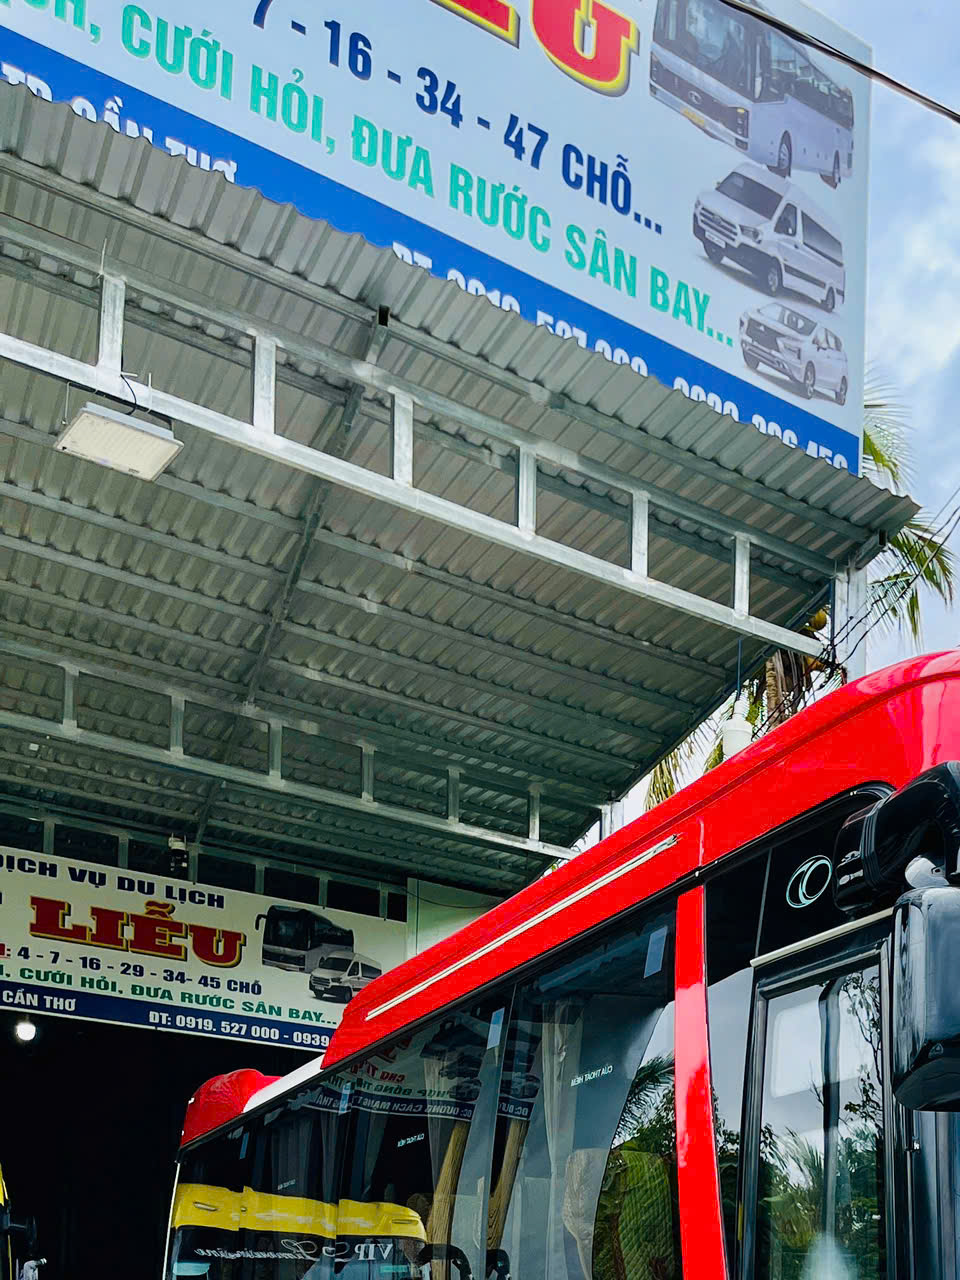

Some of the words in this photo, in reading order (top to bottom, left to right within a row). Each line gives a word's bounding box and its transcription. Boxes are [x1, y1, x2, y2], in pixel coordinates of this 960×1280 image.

[323, 20, 372, 80] 16
[416, 66, 463, 129] 34
[504, 113, 549, 171] 47
[561, 143, 663, 235] CHỖ...
[122, 5, 234, 101] CƯỚI
[249, 64, 335, 156] HỎI,
[351, 114, 436, 198] ĐƯA
[449, 162, 552, 253] RƯỚC
[564, 222, 637, 299] SÂN
[650, 266, 733, 348] BAY...
[0, 855, 57, 878] ỊCH
[68, 866, 107, 889] VỤ
[117, 876, 155, 896] DU
[165, 885, 225, 909] LỊCH
[29, 895, 247, 969] LIỄU
[17, 946, 30, 960] 4
[50, 951, 60, 964] 7
[79, 956, 101, 970] 16
[120, 962, 144, 977] 29
[197, 975, 221, 989] 45
[19, 967, 73, 986] CƯỚI
[131, 984, 173, 1001] ĐƯA
[180, 990, 235, 1009] RƯỚC
[241, 1000, 282, 1017] SÂN
[43, 995, 77, 1011] THƠ
[175, 1015, 217, 1032] 0919.
[220, 1021, 248, 1036] 527
[251, 1025, 280, 1041] 000
[293, 1032, 330, 1047] 0939
